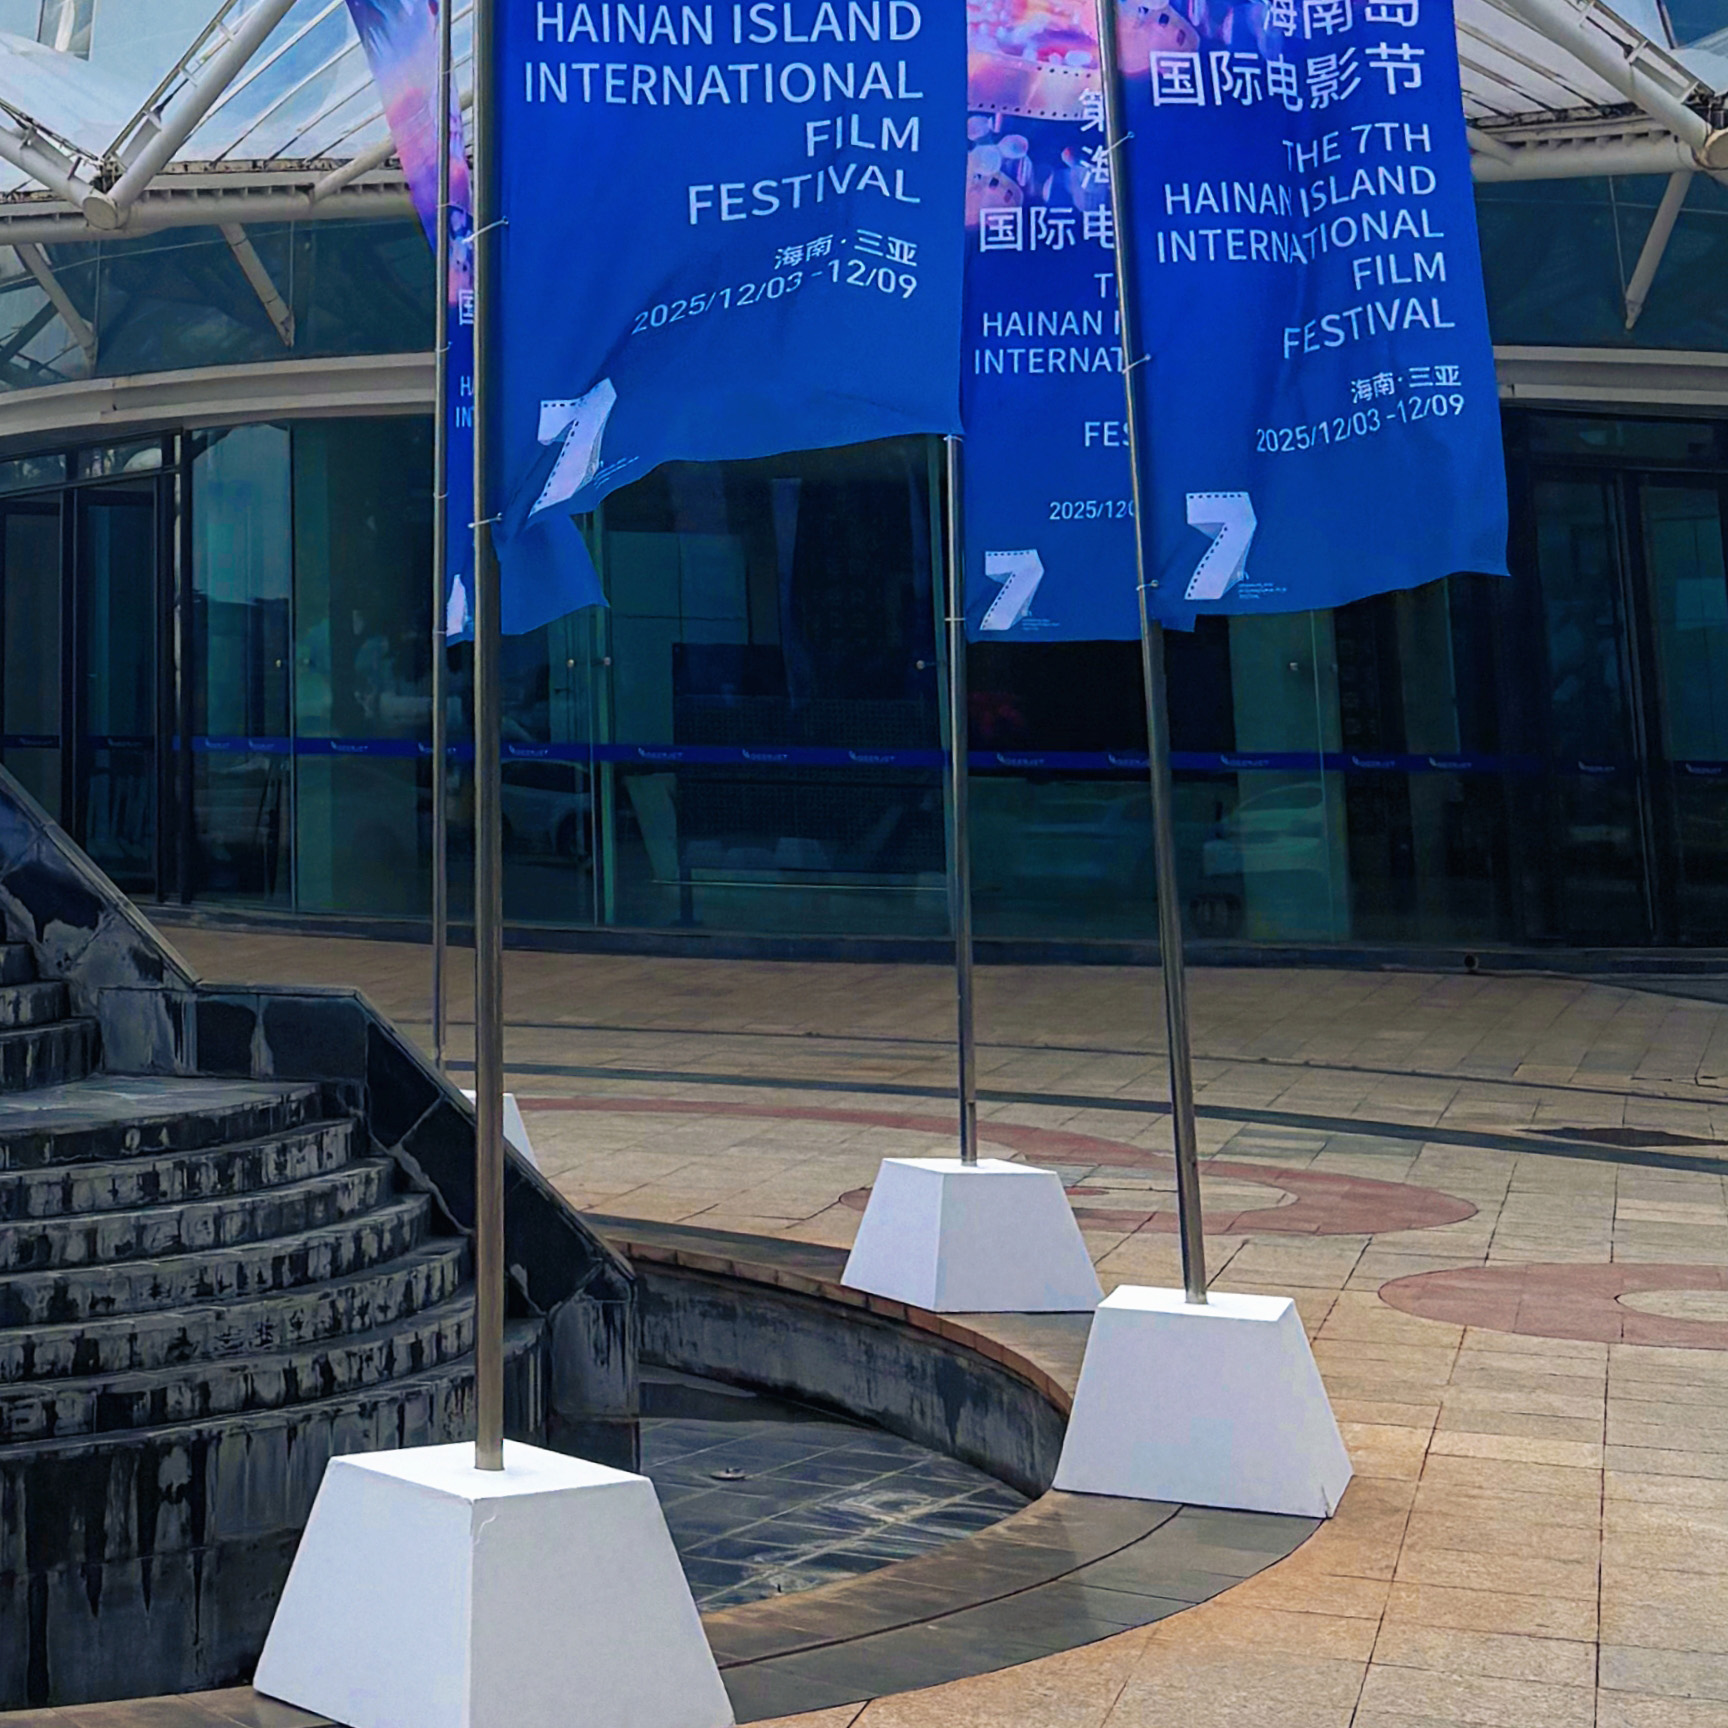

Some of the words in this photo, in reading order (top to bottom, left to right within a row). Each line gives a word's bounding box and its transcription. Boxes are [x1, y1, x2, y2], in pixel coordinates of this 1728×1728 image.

[535, 1, 713, 46] HAINAN
[733, 0, 922, 44] ISLAND
[524, 60, 923, 106] INTERNATIONAL
[1148, 40, 1426, 112] 国际电影节
[806, 112, 921, 158] FILM
[1282, 131, 1342, 173] THE
[1351, 122, 1432, 154] 7TH
[688, 163, 921, 225] FESTIVAL
[1164, 181, 1292, 217] HAINAN
[1299, 165, 1437, 218] ISLAND
[979, 204, 1116, 253] 国际电
[1157, 208, 1445, 265] INTERNATIONAL
[1352, 251, 1447, 291] FILM
[631, 271, 803, 335] 2025/12/03
[983, 310, 1102, 338] HAINAN
[1283, 296, 1456, 360] FESTIVAL
[974, 346, 1124, 375] INTERNAT
[1256, 408, 1381, 452] 2025/12/03
